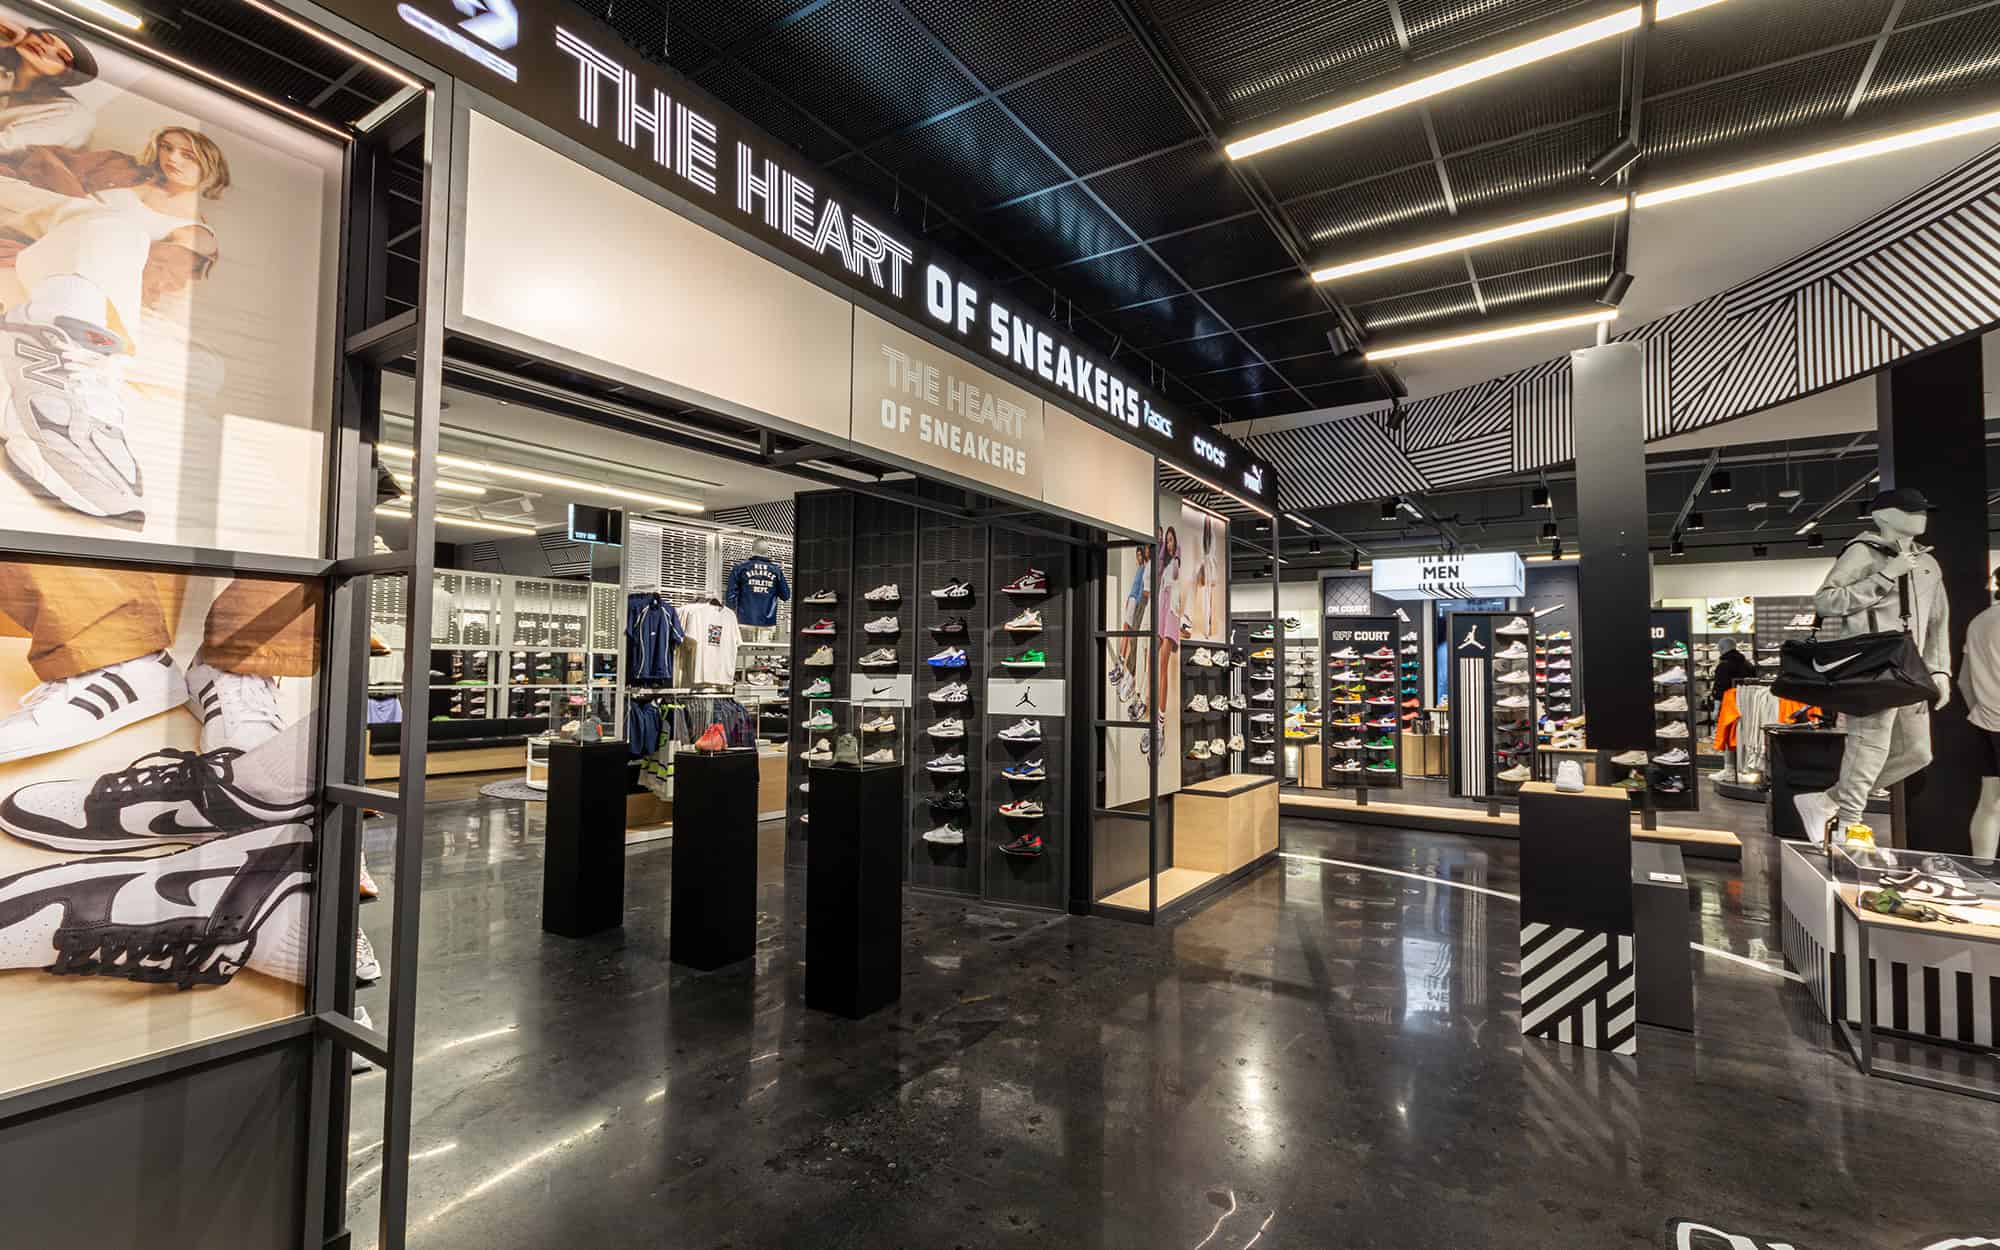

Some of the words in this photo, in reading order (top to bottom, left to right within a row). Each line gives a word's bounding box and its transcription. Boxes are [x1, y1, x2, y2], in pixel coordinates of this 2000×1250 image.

[554, 26, 717, 195] THE
[736, 140, 913, 299] HEART
[926, 263, 978, 336] OF
[988, 302, 1140, 429] SNEAKERS
[881, 344, 940, 406] THE
[947, 375, 1026, 440] HEART
[881, 399, 912, 433] OF
[920, 413, 1026, 475] SNEAKERS
[1193, 435, 1226, 468] crocs
[1423, 565, 1459, 579] MEN
[1341, 605, 1367, 613] COURT
[1354, 631, 1390, 641] COURT
